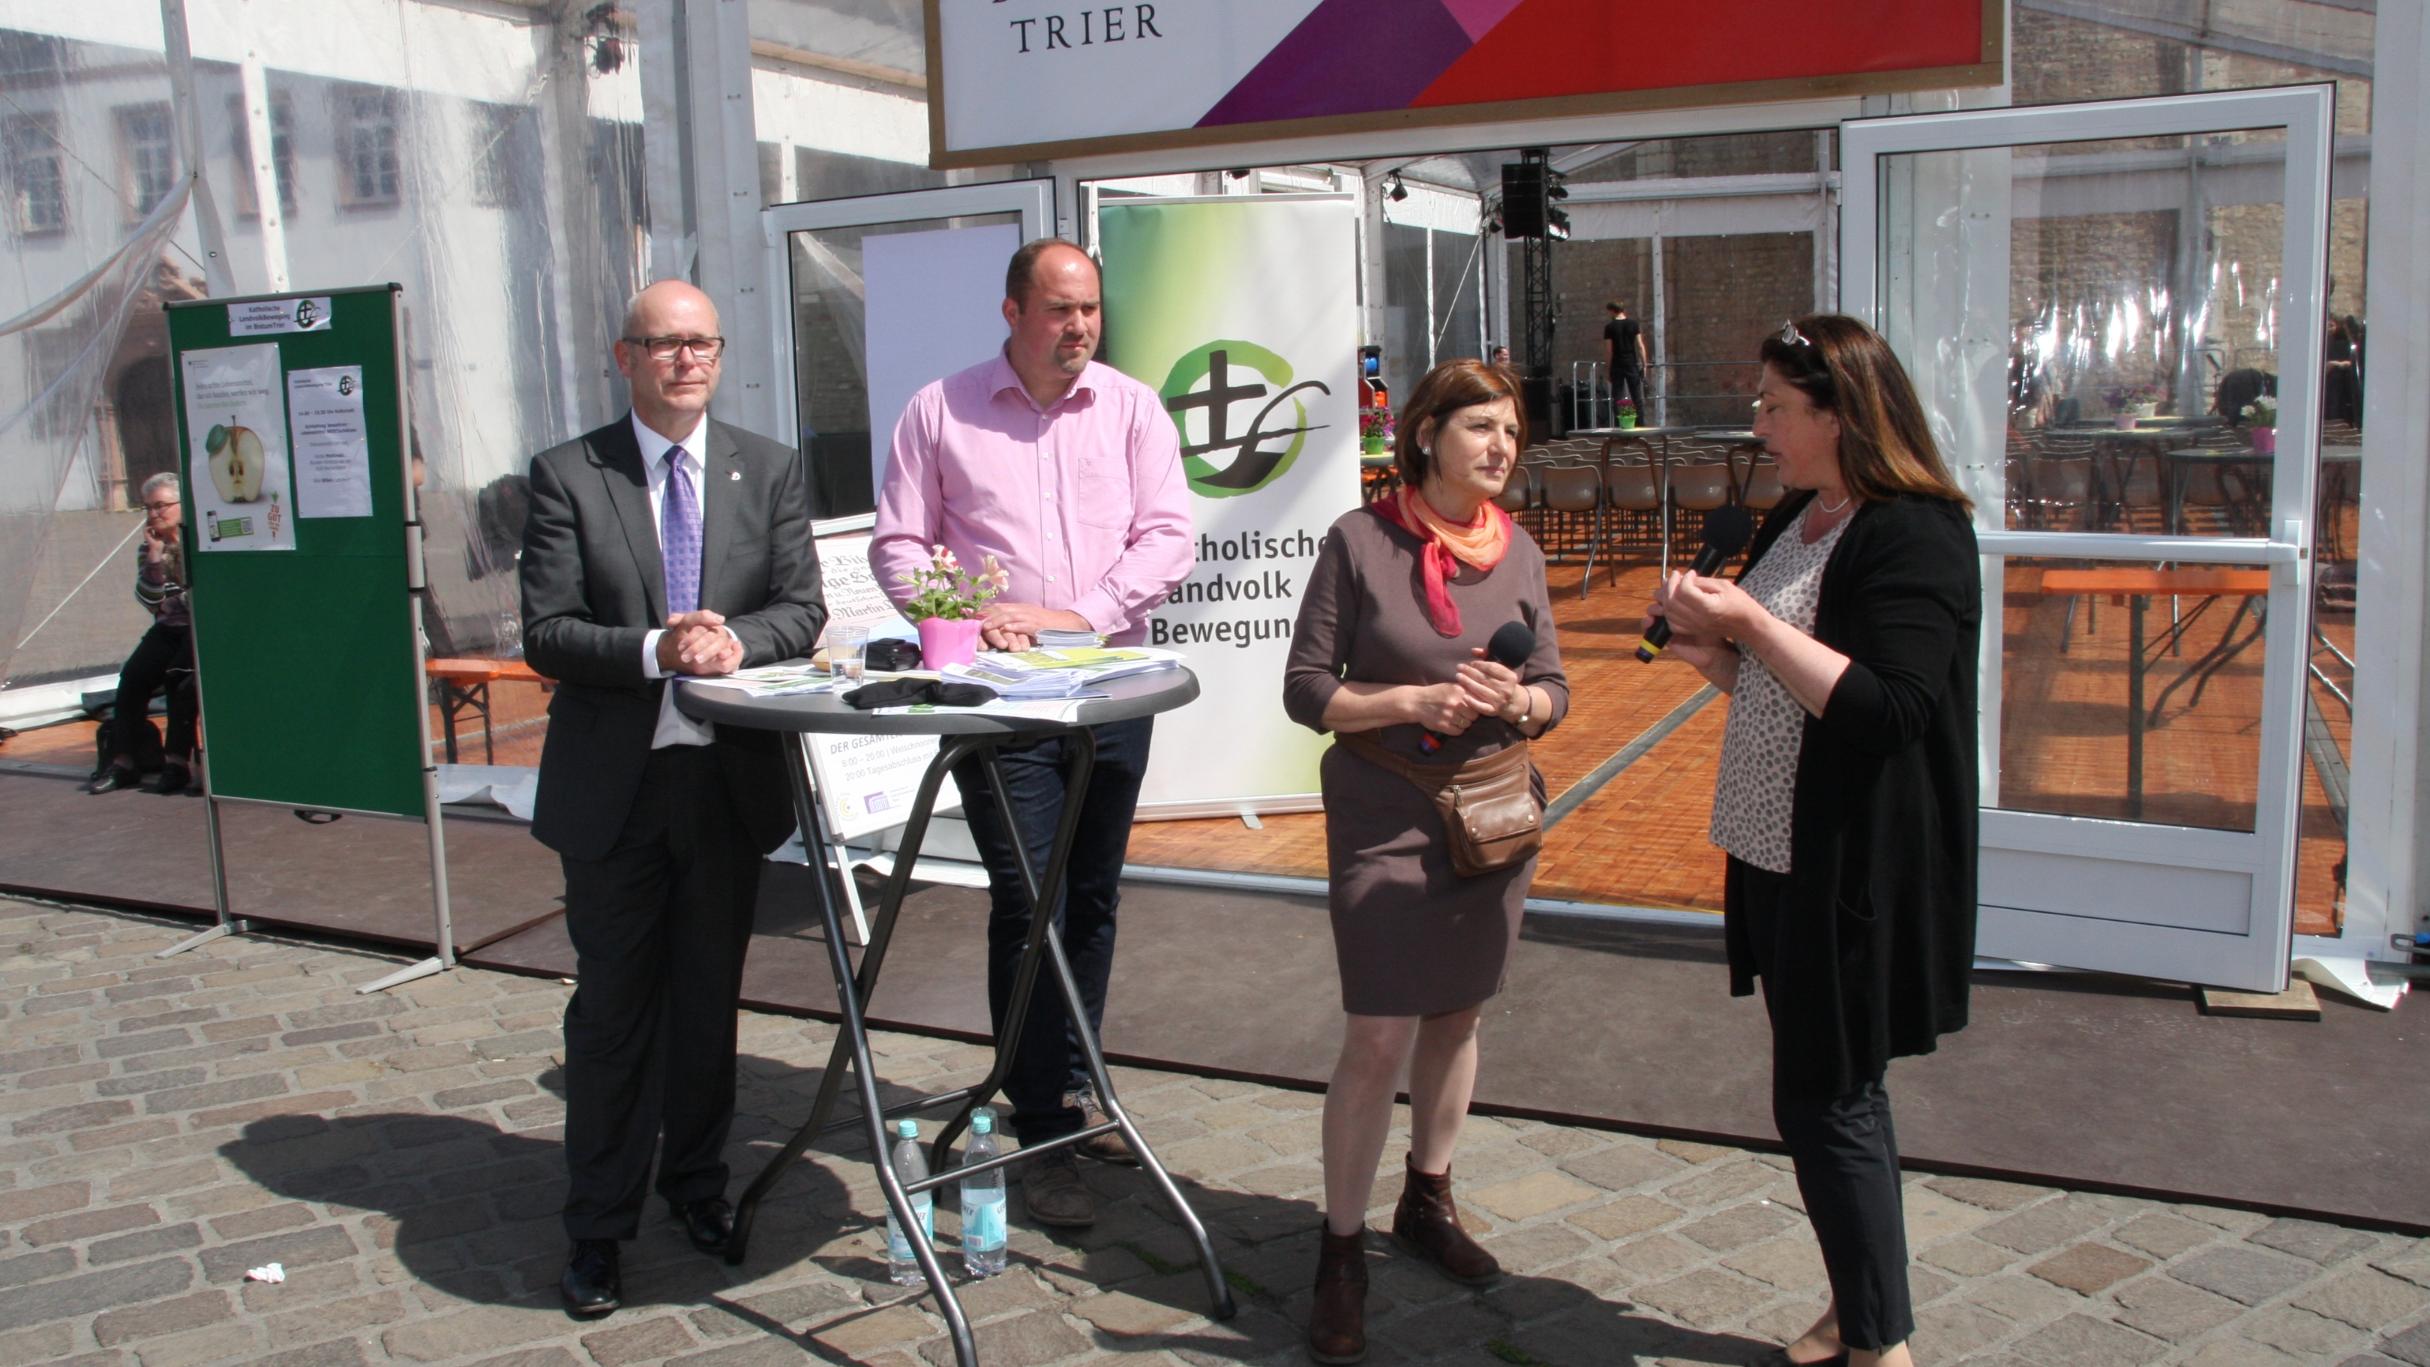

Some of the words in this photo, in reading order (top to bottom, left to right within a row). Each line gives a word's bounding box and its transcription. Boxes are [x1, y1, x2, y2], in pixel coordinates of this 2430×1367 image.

[1009, 4, 1163, 54] TRIER
[1162, 570, 1292, 605] andvolk
[832, 602, 885, 618] Martin
[1151, 617, 1291, 649] Bewegun
[830, 741, 849, 755] DER
